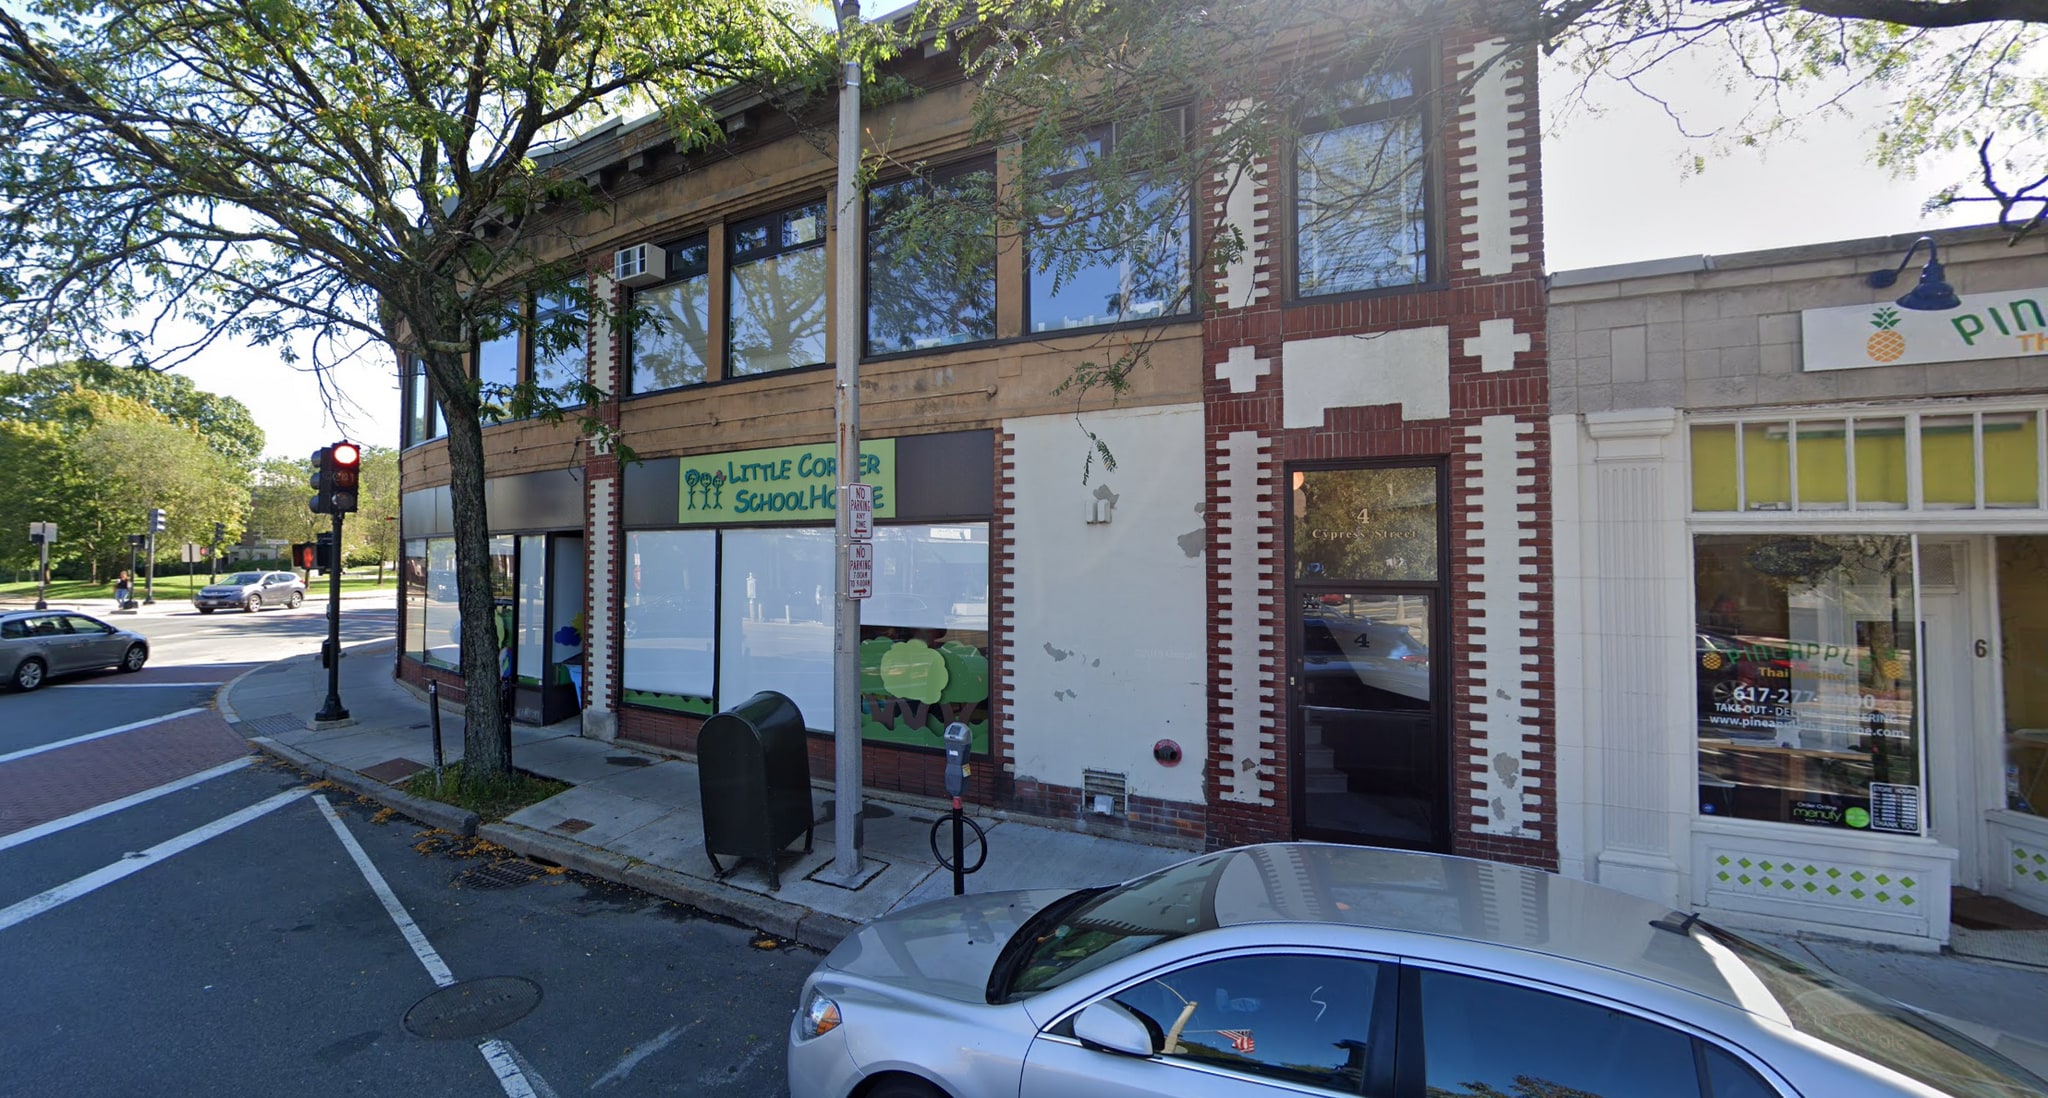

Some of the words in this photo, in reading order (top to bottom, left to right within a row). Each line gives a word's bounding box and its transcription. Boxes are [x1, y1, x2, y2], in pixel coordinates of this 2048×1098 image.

[728, 459, 792, 484] LITTLE
[797, 452, 880, 478] CORER
[734, 484, 884, 513] SCHOOLHOE
[856, 487, 866, 500] NO
[850, 499, 871, 512] PARKING
[856, 512, 866, 520] ANY
[1356, 508, 1370, 524] 4
[856, 520, 867, 528] TIME
[1312, 528, 1366, 541] Cypress
[1374, 528, 1417, 539] Street
[856, 547, 866, 559] NO
[850, 559, 871, 571] PARKING
[1354, 633, 1370, 648] 4
[1974, 639, 1987, 658] 6
[1759, 666, 1789, 678] Thai
[1793, 808, 1842, 823] menufy
